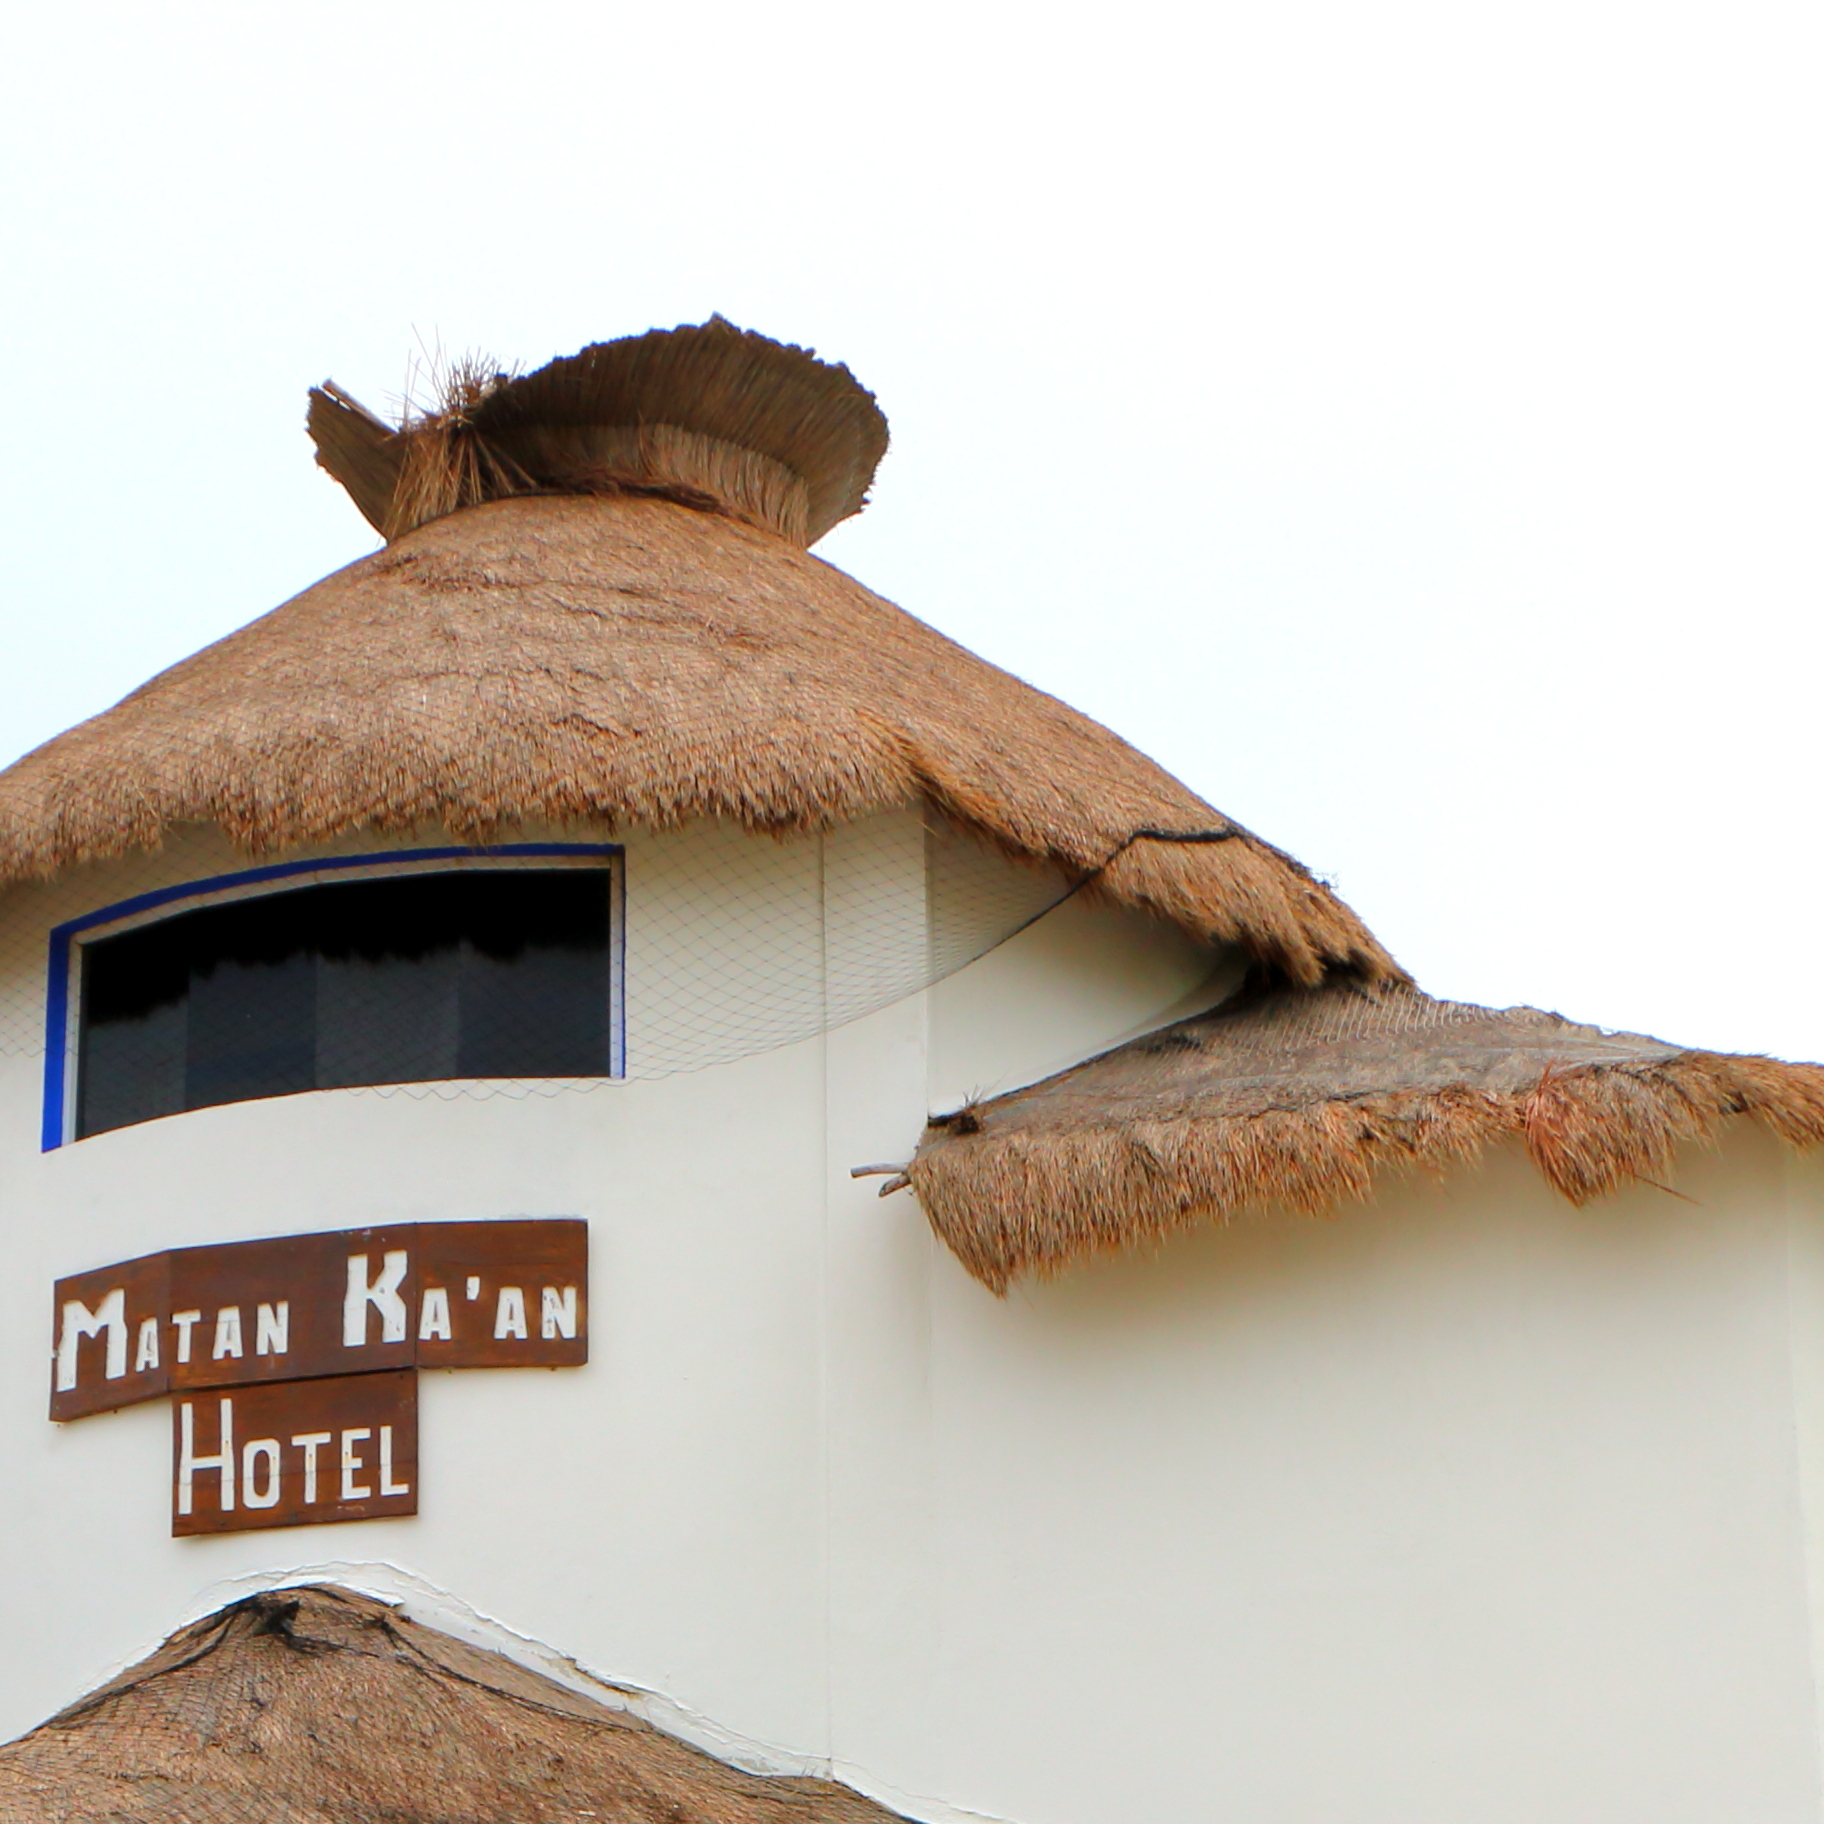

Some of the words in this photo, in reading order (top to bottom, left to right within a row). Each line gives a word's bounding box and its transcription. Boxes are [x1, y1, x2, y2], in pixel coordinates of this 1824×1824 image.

[56, 1288, 290, 1393] MATAN
[342, 1249, 578, 1347] KA'AN
[177, 1398, 410, 1515] HOTEL
